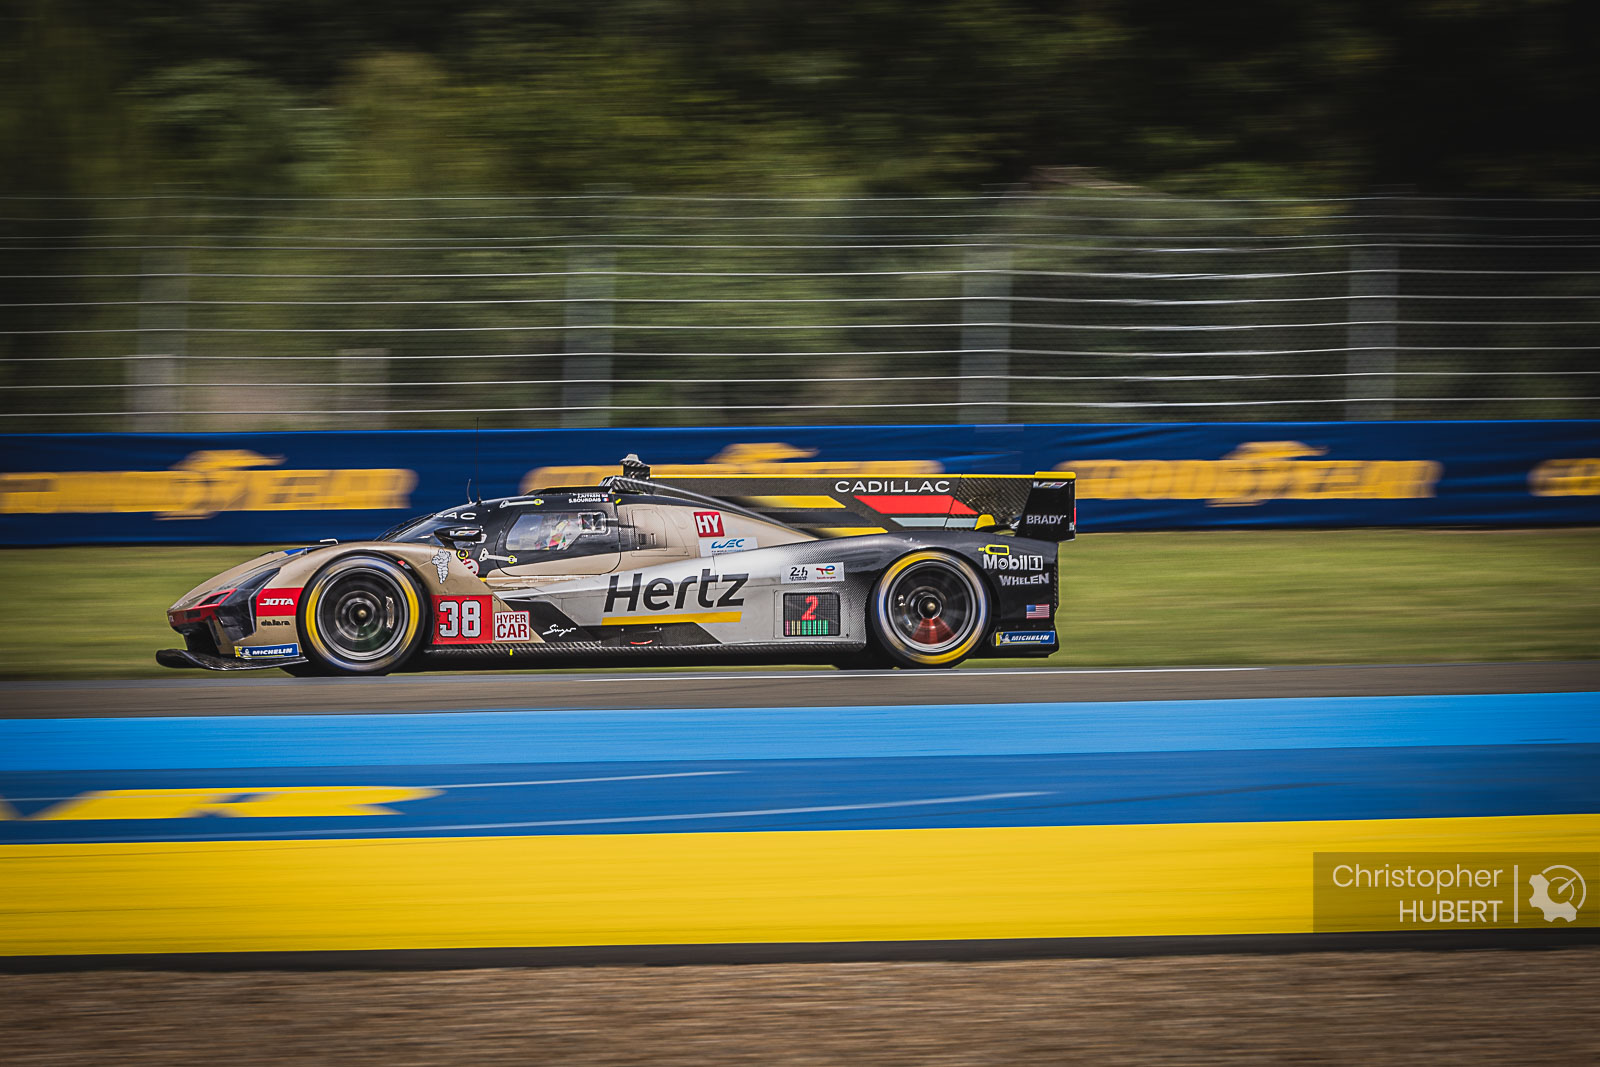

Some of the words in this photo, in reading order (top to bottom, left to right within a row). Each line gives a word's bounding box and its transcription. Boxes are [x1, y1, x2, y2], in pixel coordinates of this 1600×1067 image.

[835, 480, 950, 493] CADILLAC
[695, 515, 720, 534] HY
[1026, 514, 1063, 525] BRADY
[711, 538, 745, 549] WEC
[983, 554, 1028, 571] Mobil
[999, 573, 1050, 587] WHELEN
[603, 568, 750, 612] Hertz
[259, 598, 294, 606] JOTA
[801, 595, 819, 620] 2
[439, 600, 481, 638] 38
[496, 614, 527, 624] HYPER
[496, 624, 528, 638] CAR
[252, 647, 293, 656] MICHELIN
